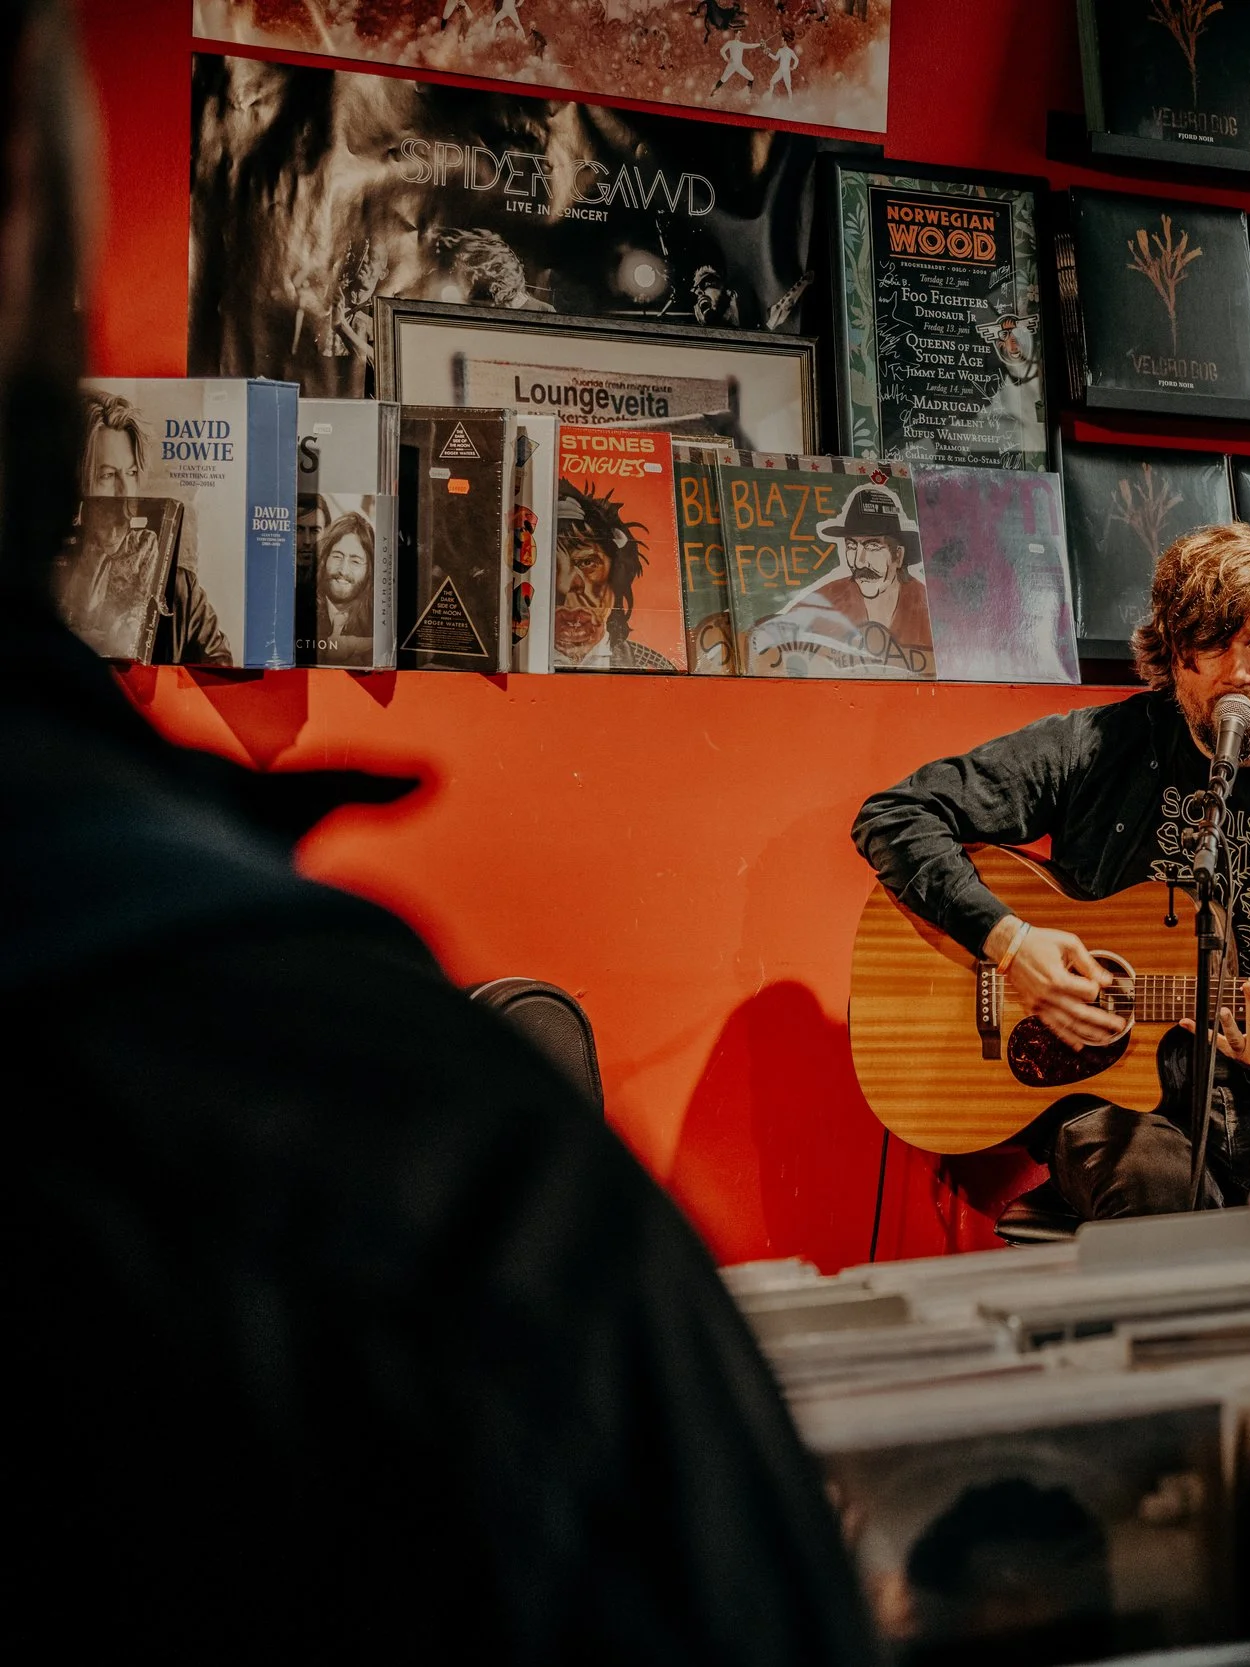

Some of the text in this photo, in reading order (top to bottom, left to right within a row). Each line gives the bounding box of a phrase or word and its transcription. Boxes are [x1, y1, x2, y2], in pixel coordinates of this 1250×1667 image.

[1178, 132, 1197, 140] FJORD
[568, 159, 716, 217] GAWD
[506, 201, 609, 222] LIVE IN CONCERT
[887, 206, 995, 231] NORWEGIAN
[887, 223, 996, 260] WOOD
[920, 274, 943, 285] Torsdag
[956, 278, 970, 288] juni
[923, 322, 944, 334] Fredag
[957, 326, 970, 335] juni
[514, 375, 669, 417] Loungeveita
[961, 386, 974, 395] juni
[165, 419, 230, 439] DAVID
[161, 441, 234, 461] BOWIE
[561, 435, 655, 453] STONES
[561, 453, 646, 478] TONGUES
[254, 505, 289, 519] DAVID
[731, 479, 838, 541] BLAZE
[252, 519, 291, 532] BOWIE
[734, 543, 838, 595] FOLEY
